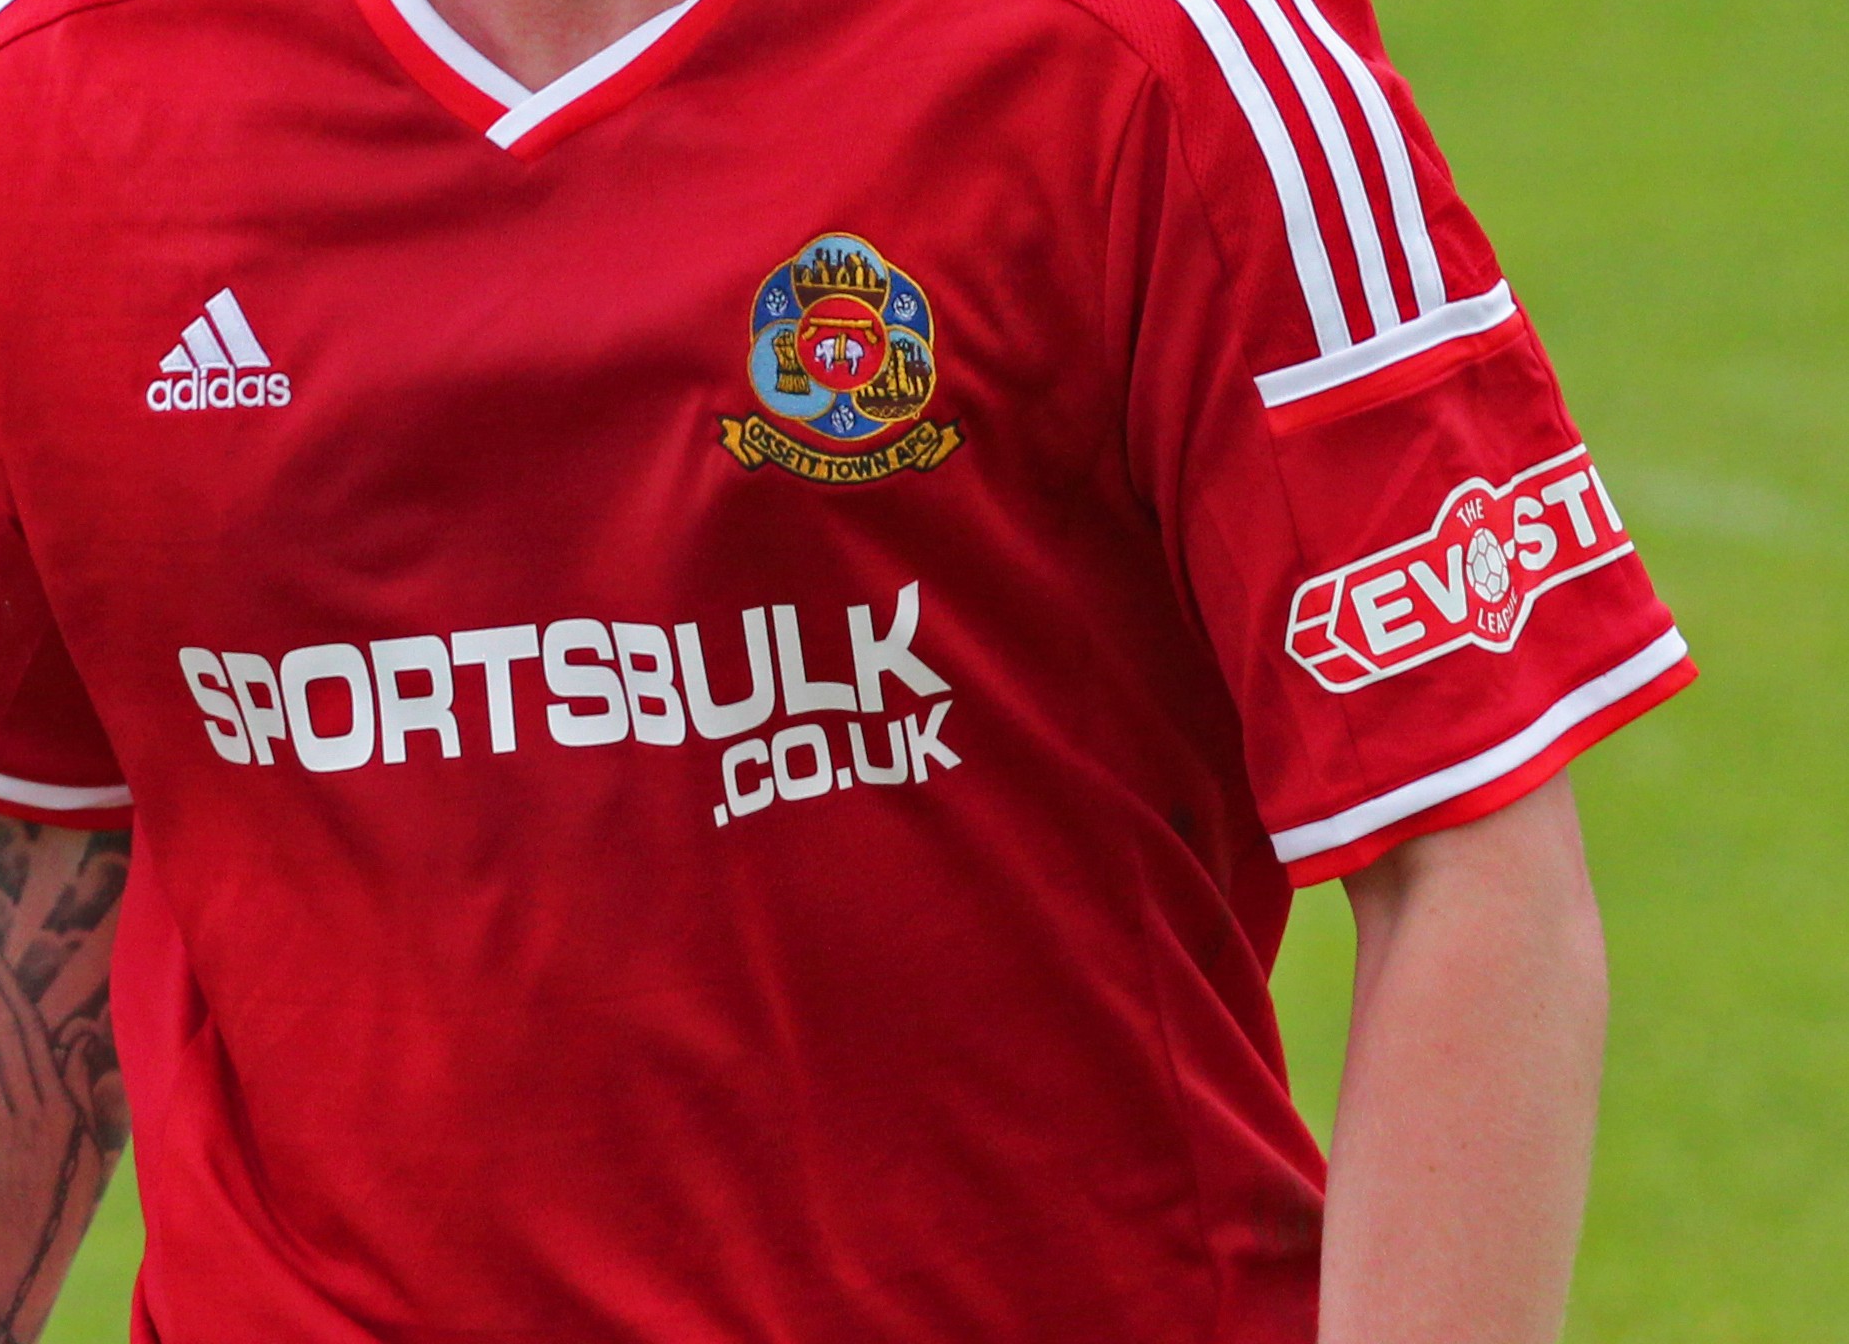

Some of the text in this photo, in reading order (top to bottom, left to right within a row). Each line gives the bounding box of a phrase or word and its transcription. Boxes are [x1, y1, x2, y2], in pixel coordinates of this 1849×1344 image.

[146, 367, 290, 412] adidas
[748, 423, 934, 481] OSSETT TOWN AFC
[1456, 497, 1485, 529] THE
[1350, 464, 1624, 656] EVO-STI
[1477, 586, 1519, 635] LEAGUE
[178, 580, 952, 773] SPORTSBULK
[713, 700, 962, 828] .CO.UK
